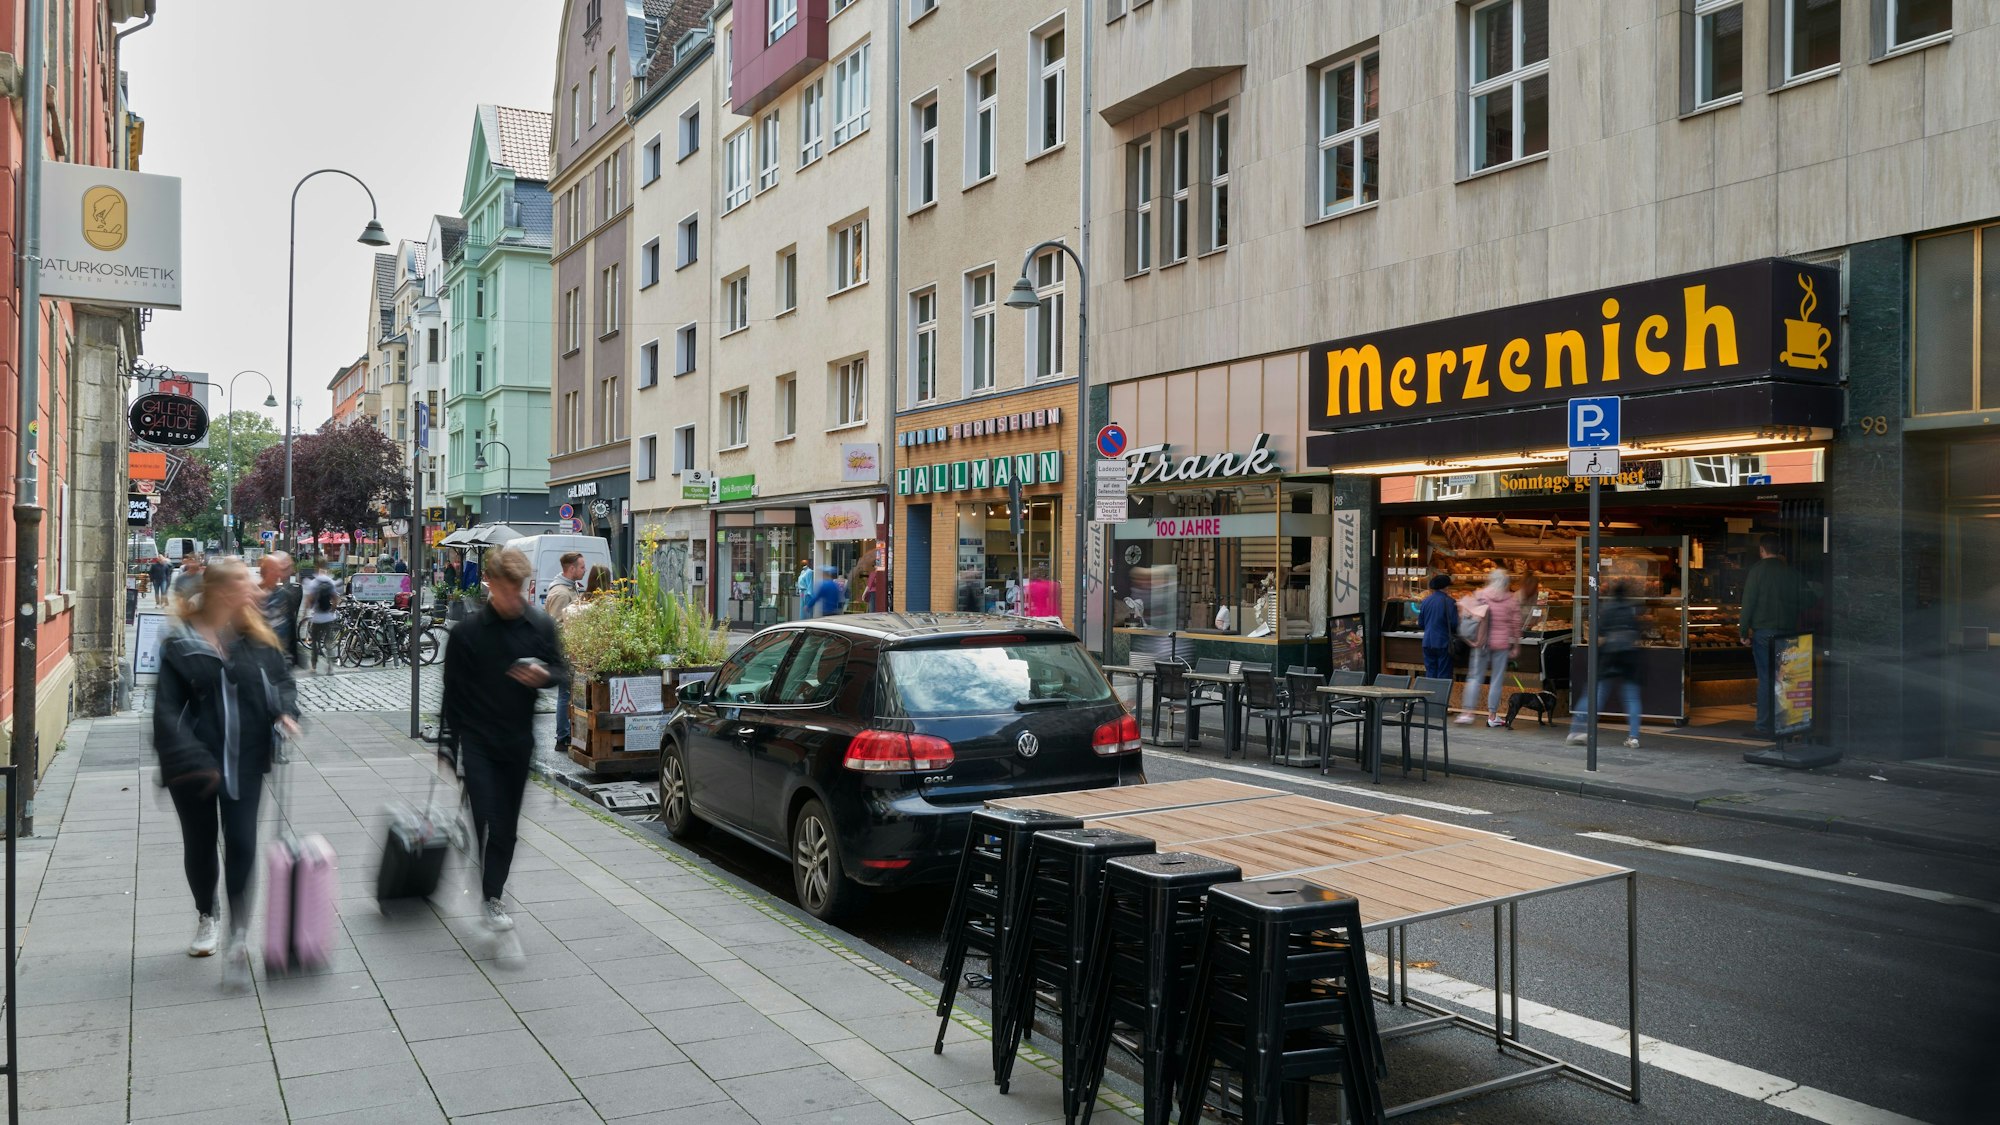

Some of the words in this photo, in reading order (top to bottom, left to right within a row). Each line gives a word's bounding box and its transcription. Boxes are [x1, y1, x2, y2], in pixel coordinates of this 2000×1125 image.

[58, 275, 102, 283] ALTEN
[114, 279, 176, 289] RATHAUS
[141, 399, 199, 417] GALERIE
[421, 409, 428, 442] P
[898, 427, 946, 447] RADIO
[952, 407, 1061, 439] FERNSEHEN
[1576, 404, 1604, 442] P
[1860, 415, 1888, 435] 98
[139, 429, 162, 437] ART
[167, 432, 196, 440] DECO
[1121, 431, 1274, 486] Frank
[898, 452, 1058, 495] HALLMANN
[1500, 473, 1570, 494] Sonntags
[1334, 495, 1344, 507] 98
[1155, 520, 1176, 537] 100
[1179, 518, 1220, 536] JAHRE
[1087, 523, 1103, 594] Frank
[1334, 513, 1358, 604] Frank
[923, 775, 953, 785] GOLF
